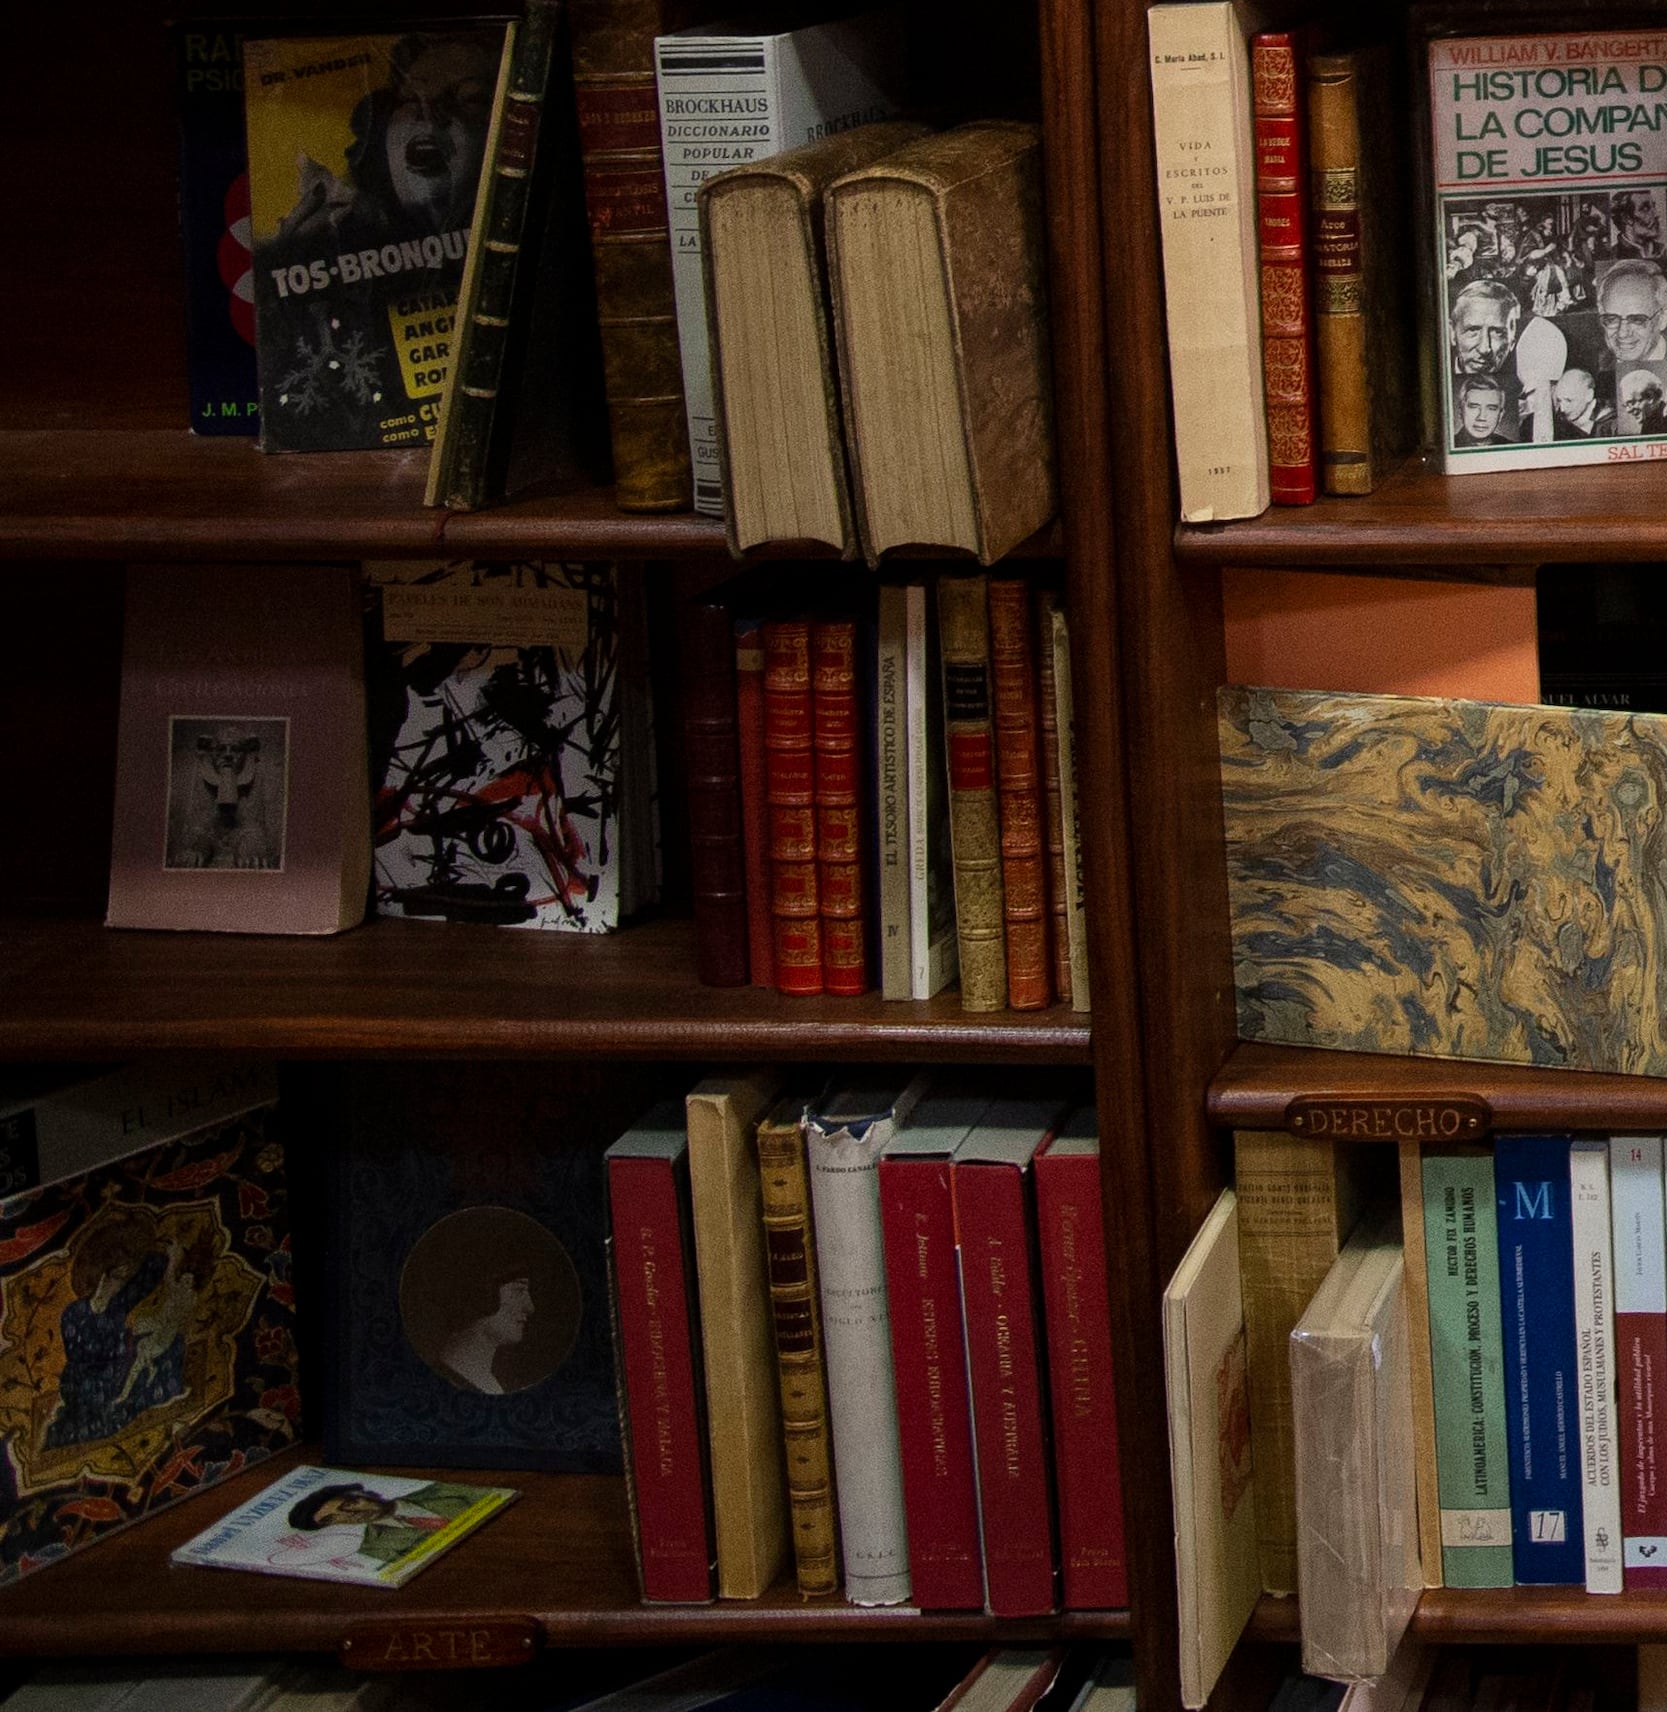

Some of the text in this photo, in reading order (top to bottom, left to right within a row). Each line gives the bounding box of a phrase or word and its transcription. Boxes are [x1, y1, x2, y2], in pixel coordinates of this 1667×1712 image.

[1449, 43, 1540, 65] WILLIAM
[1452, 65, 1628, 102] HISTORIA
[665, 97, 769, 116] BROCKHAUS
[667, 123, 771, 138] DICCIONARIO
[1454, 111, 1506, 141] LA
[682, 146, 755, 160] POPULAR
[1178, 141, 1212, 152] VIDA
[1456, 141, 1644, 180] DE JESUS
[1165, 166, 1229, 179] ESCRITOS
[1191, 207, 1227, 219] PUENTE
[219, 401, 242, 418] M.
[1607, 443, 1645, 461] SAL
[882, 655, 898, 846] TESORO ARTISTICO ESPAÑA
[1307, 1108, 1461, 1138] DERECHO
[1513, 1181, 1555, 1220] M
[1444, 1187, 1459, 1277] HECTOR ZAMUDIO
[1461, 1186, 1488, 1496] LATINOAMERICA: PROCESO DERECHOS HUMANOS
[1592, 1251, 1611, 1487] CON MUSULMANES PROTESTANTES
[1580, 1328, 1598, 1486] ACUERDOS DEL ESTADO ESPAÑOL
[383, 1629, 492, 1663] ARTE
